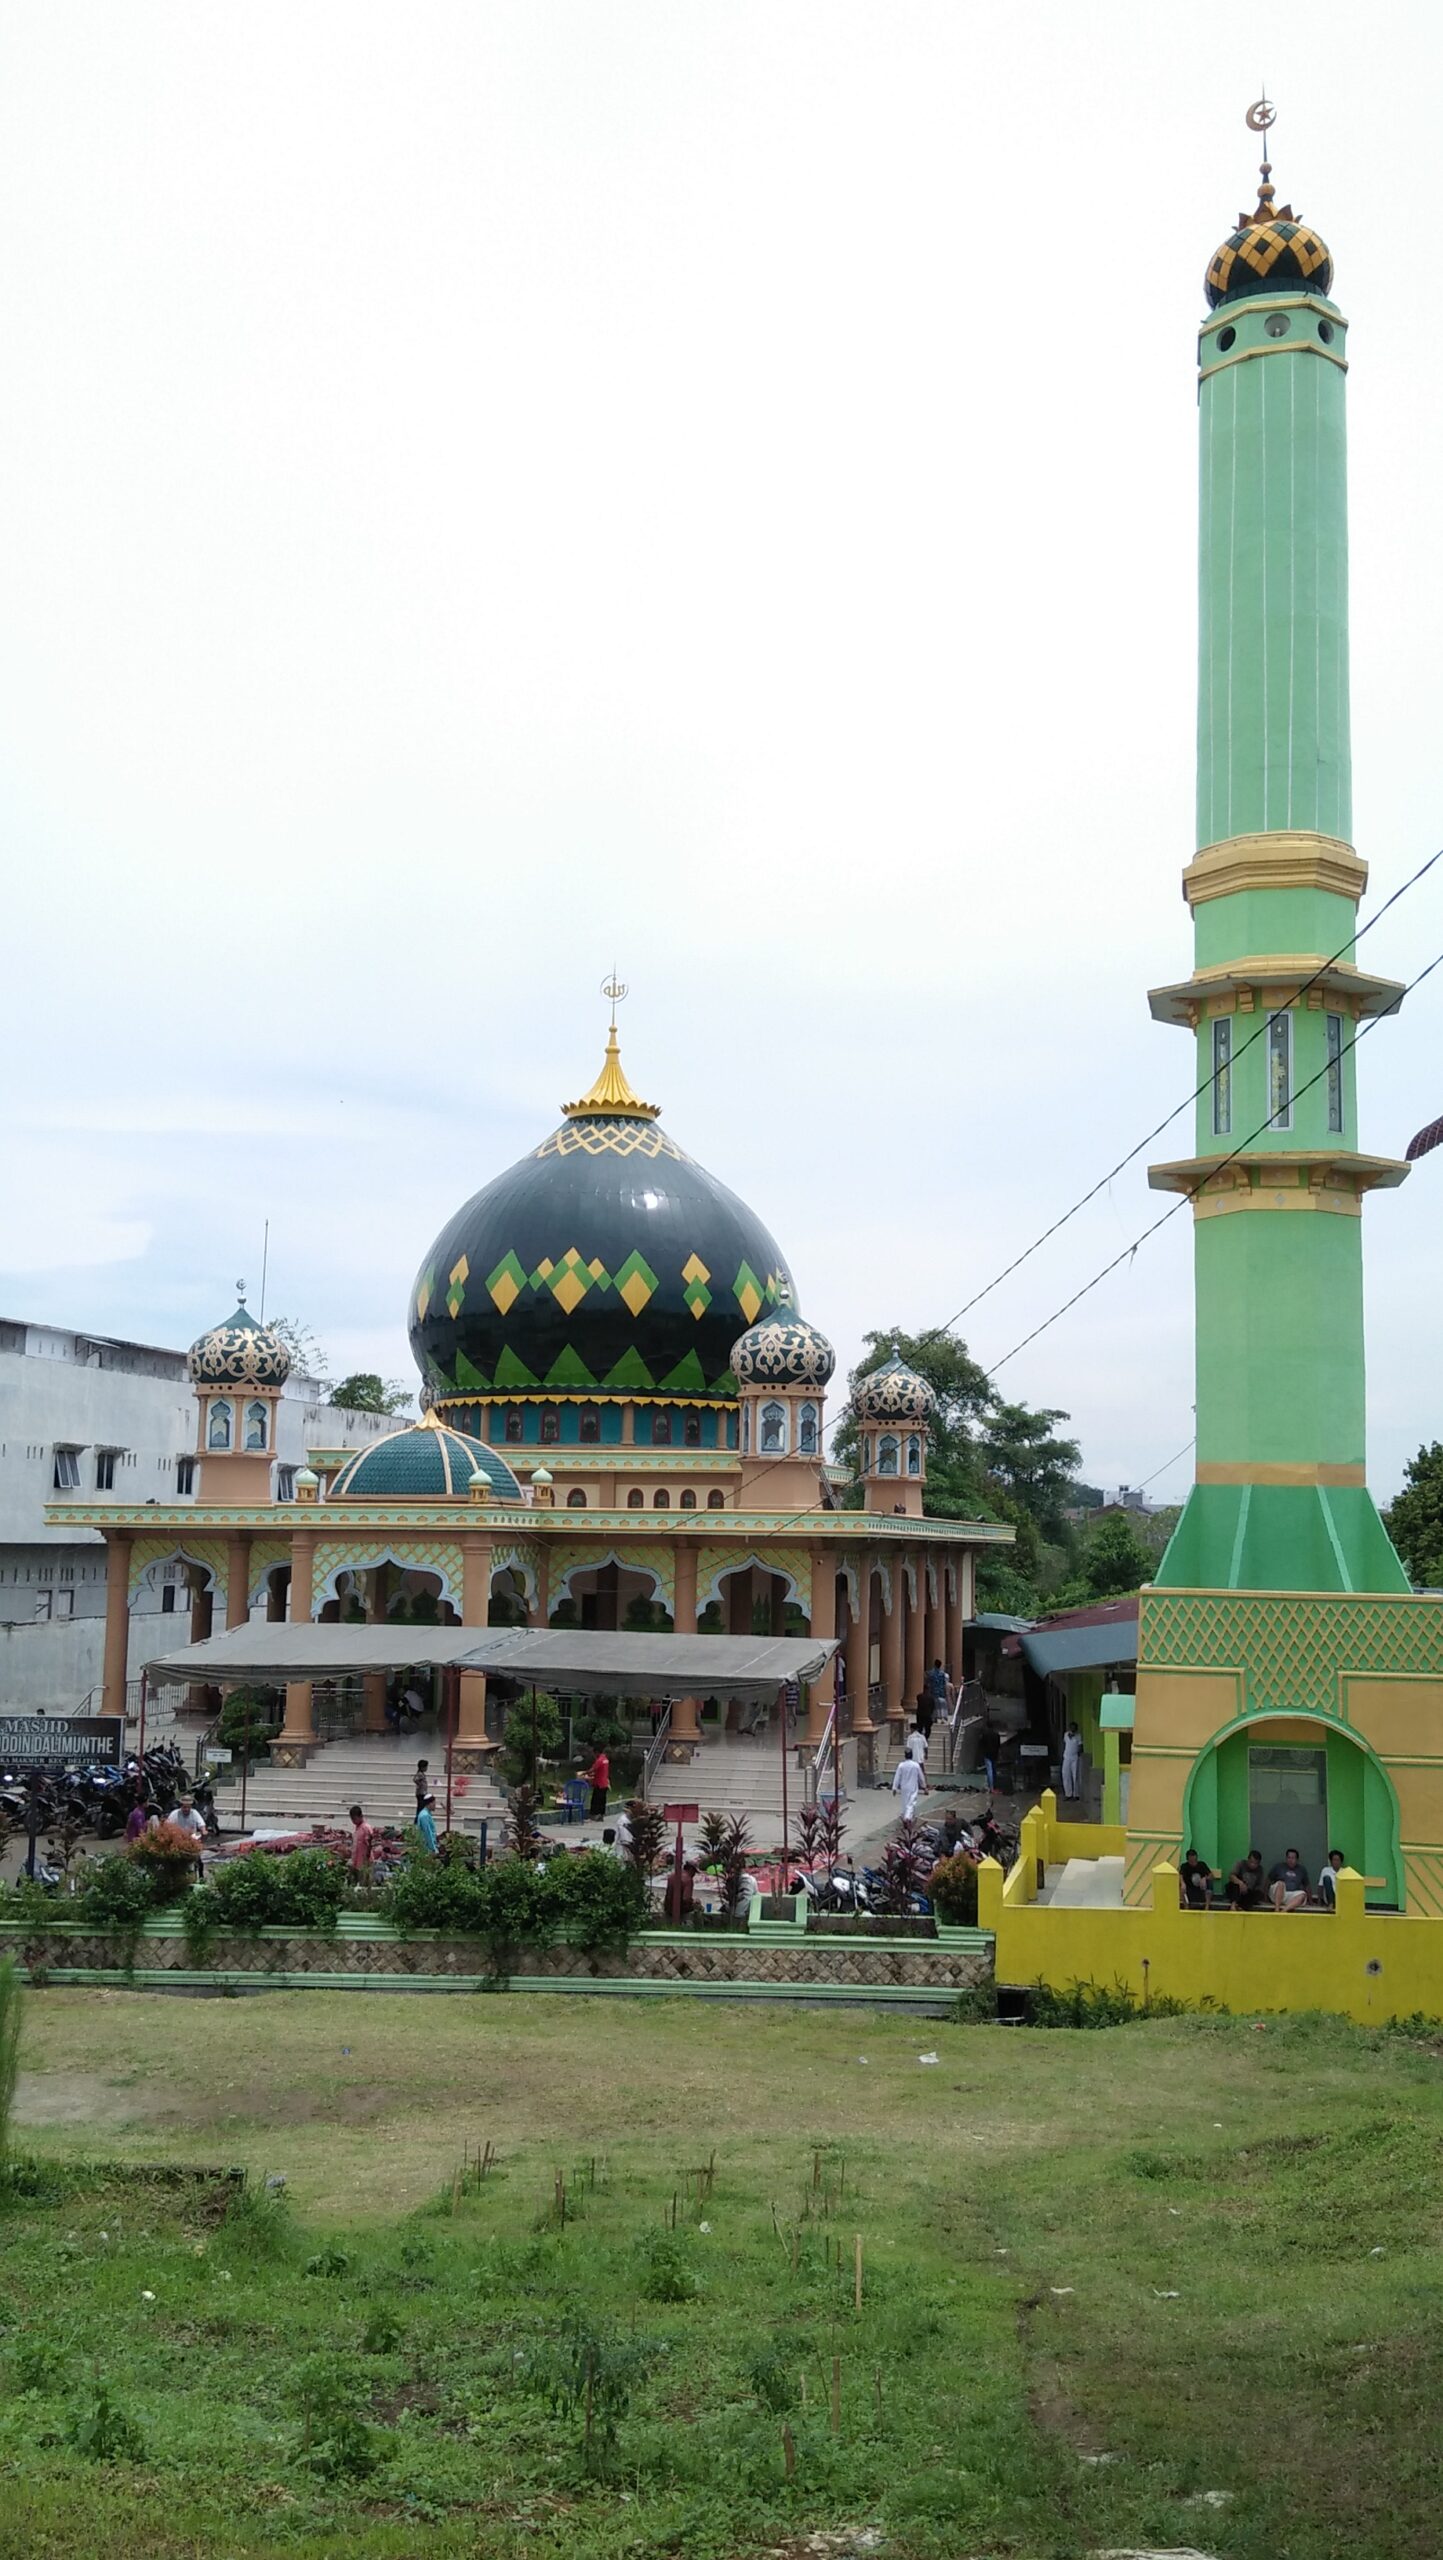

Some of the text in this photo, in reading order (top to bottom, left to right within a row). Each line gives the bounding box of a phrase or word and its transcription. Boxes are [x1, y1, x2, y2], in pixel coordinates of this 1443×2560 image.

[5, 1720, 69, 1733] MASJID
[0, 1735, 114, 1753] DDIN DALIMUNTHE
